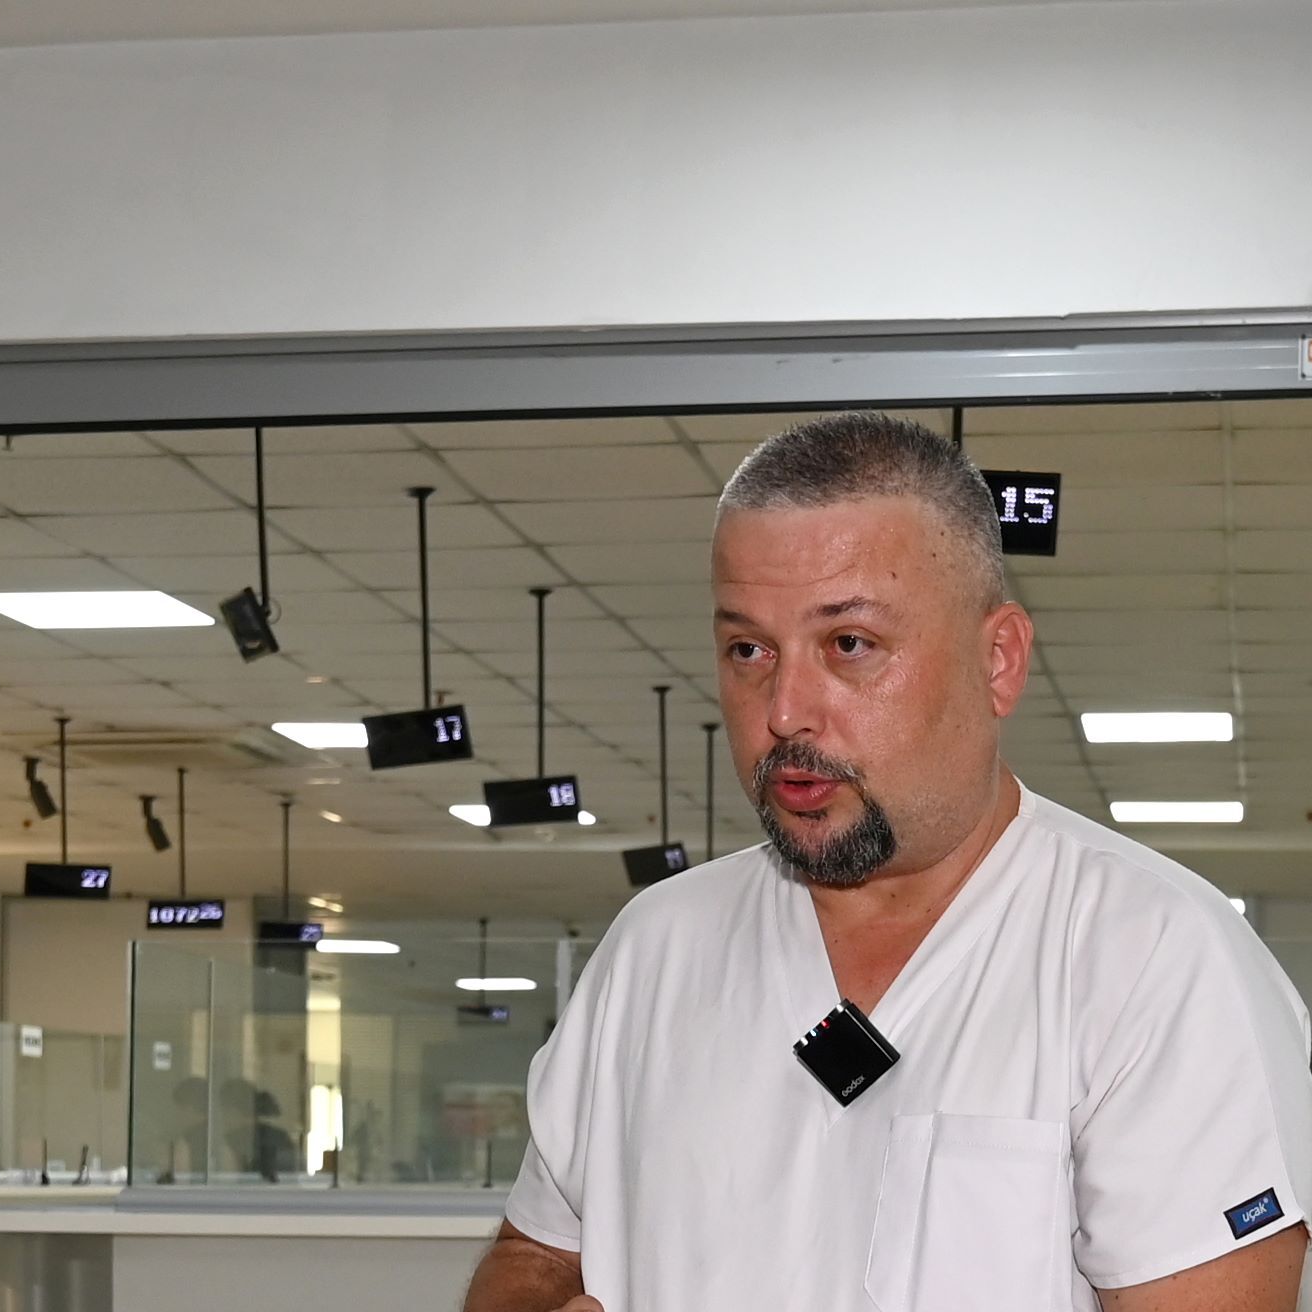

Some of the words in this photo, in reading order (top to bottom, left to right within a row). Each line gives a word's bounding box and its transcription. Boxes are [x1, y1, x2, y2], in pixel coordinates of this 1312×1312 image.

[1000, 486, 1055, 524] 15
[433, 715, 462, 743] 17
[81, 868, 109, 889] 27
[841, 1075, 865, 1097] Godox
[1242, 1201, 1268, 1223] uçak
